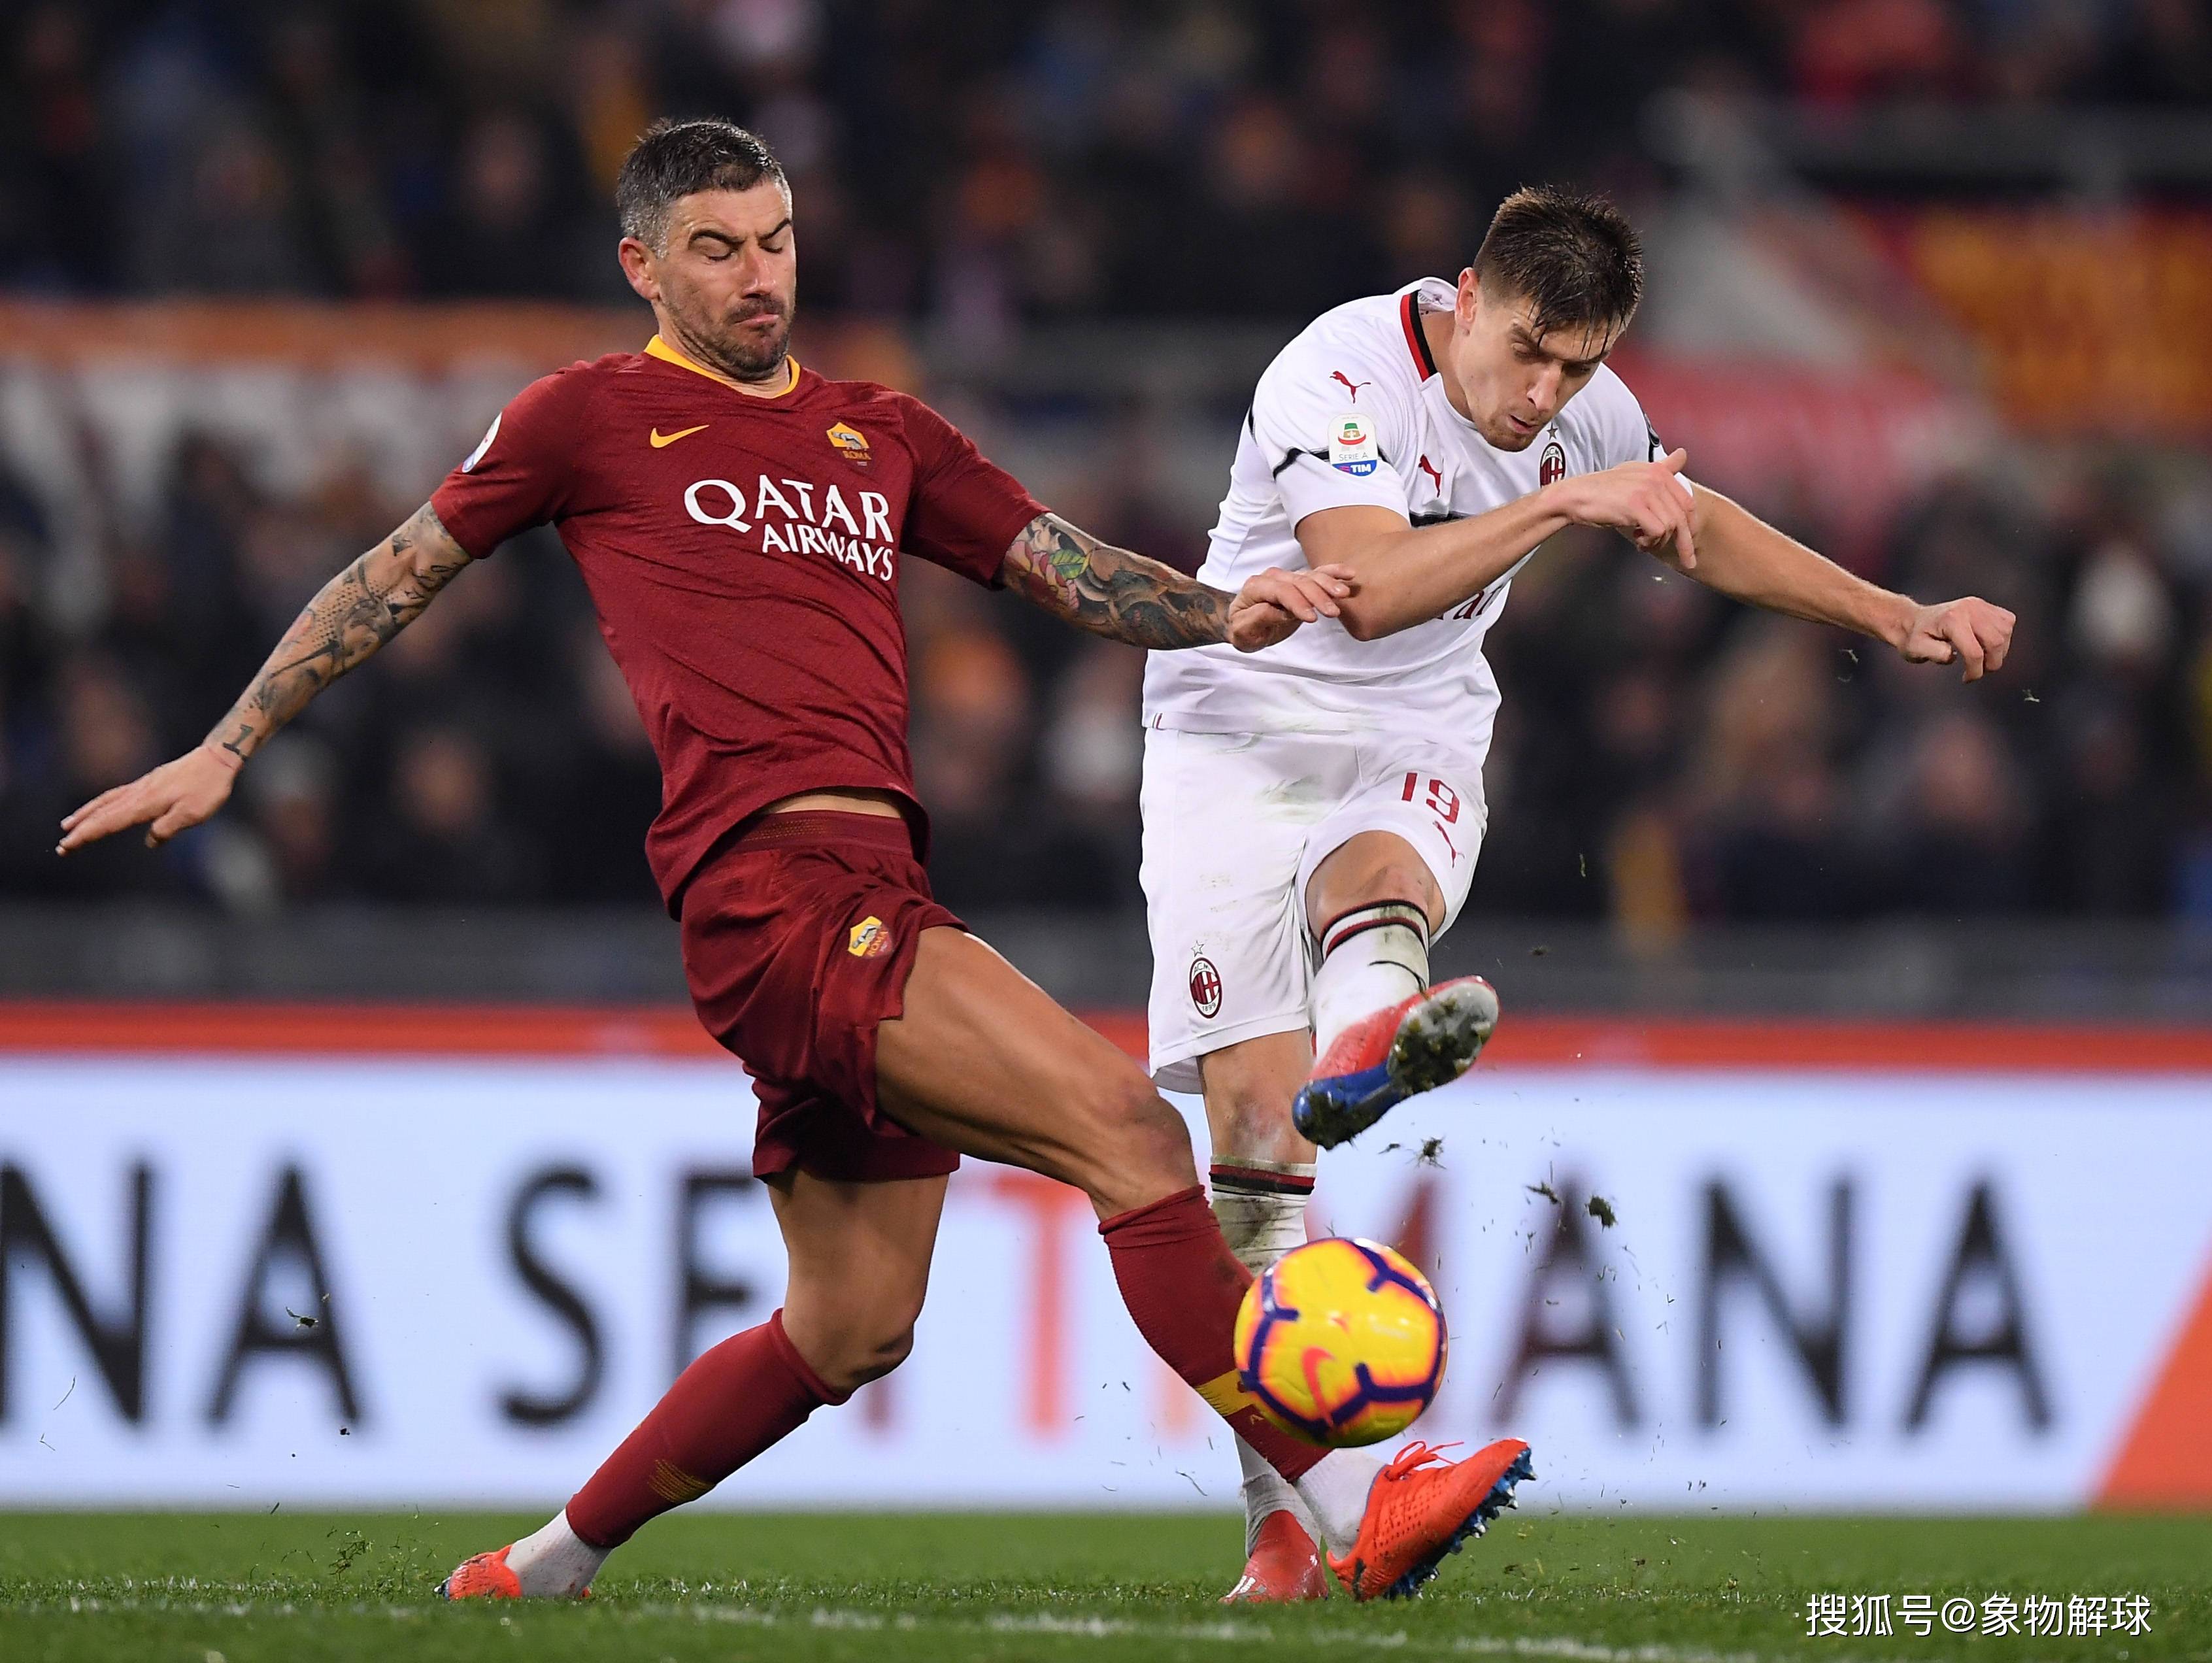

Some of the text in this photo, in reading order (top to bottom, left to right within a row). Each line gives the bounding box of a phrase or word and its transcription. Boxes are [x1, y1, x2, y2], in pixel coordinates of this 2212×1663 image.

[1339, 453, 1359, 462] SERIE
[1350, 463, 1371, 473] TIM
[684, 474, 894, 543] QATAR
[762, 523, 894, 582] AIRWAYS
[1401, 772, 1460, 825] 19
